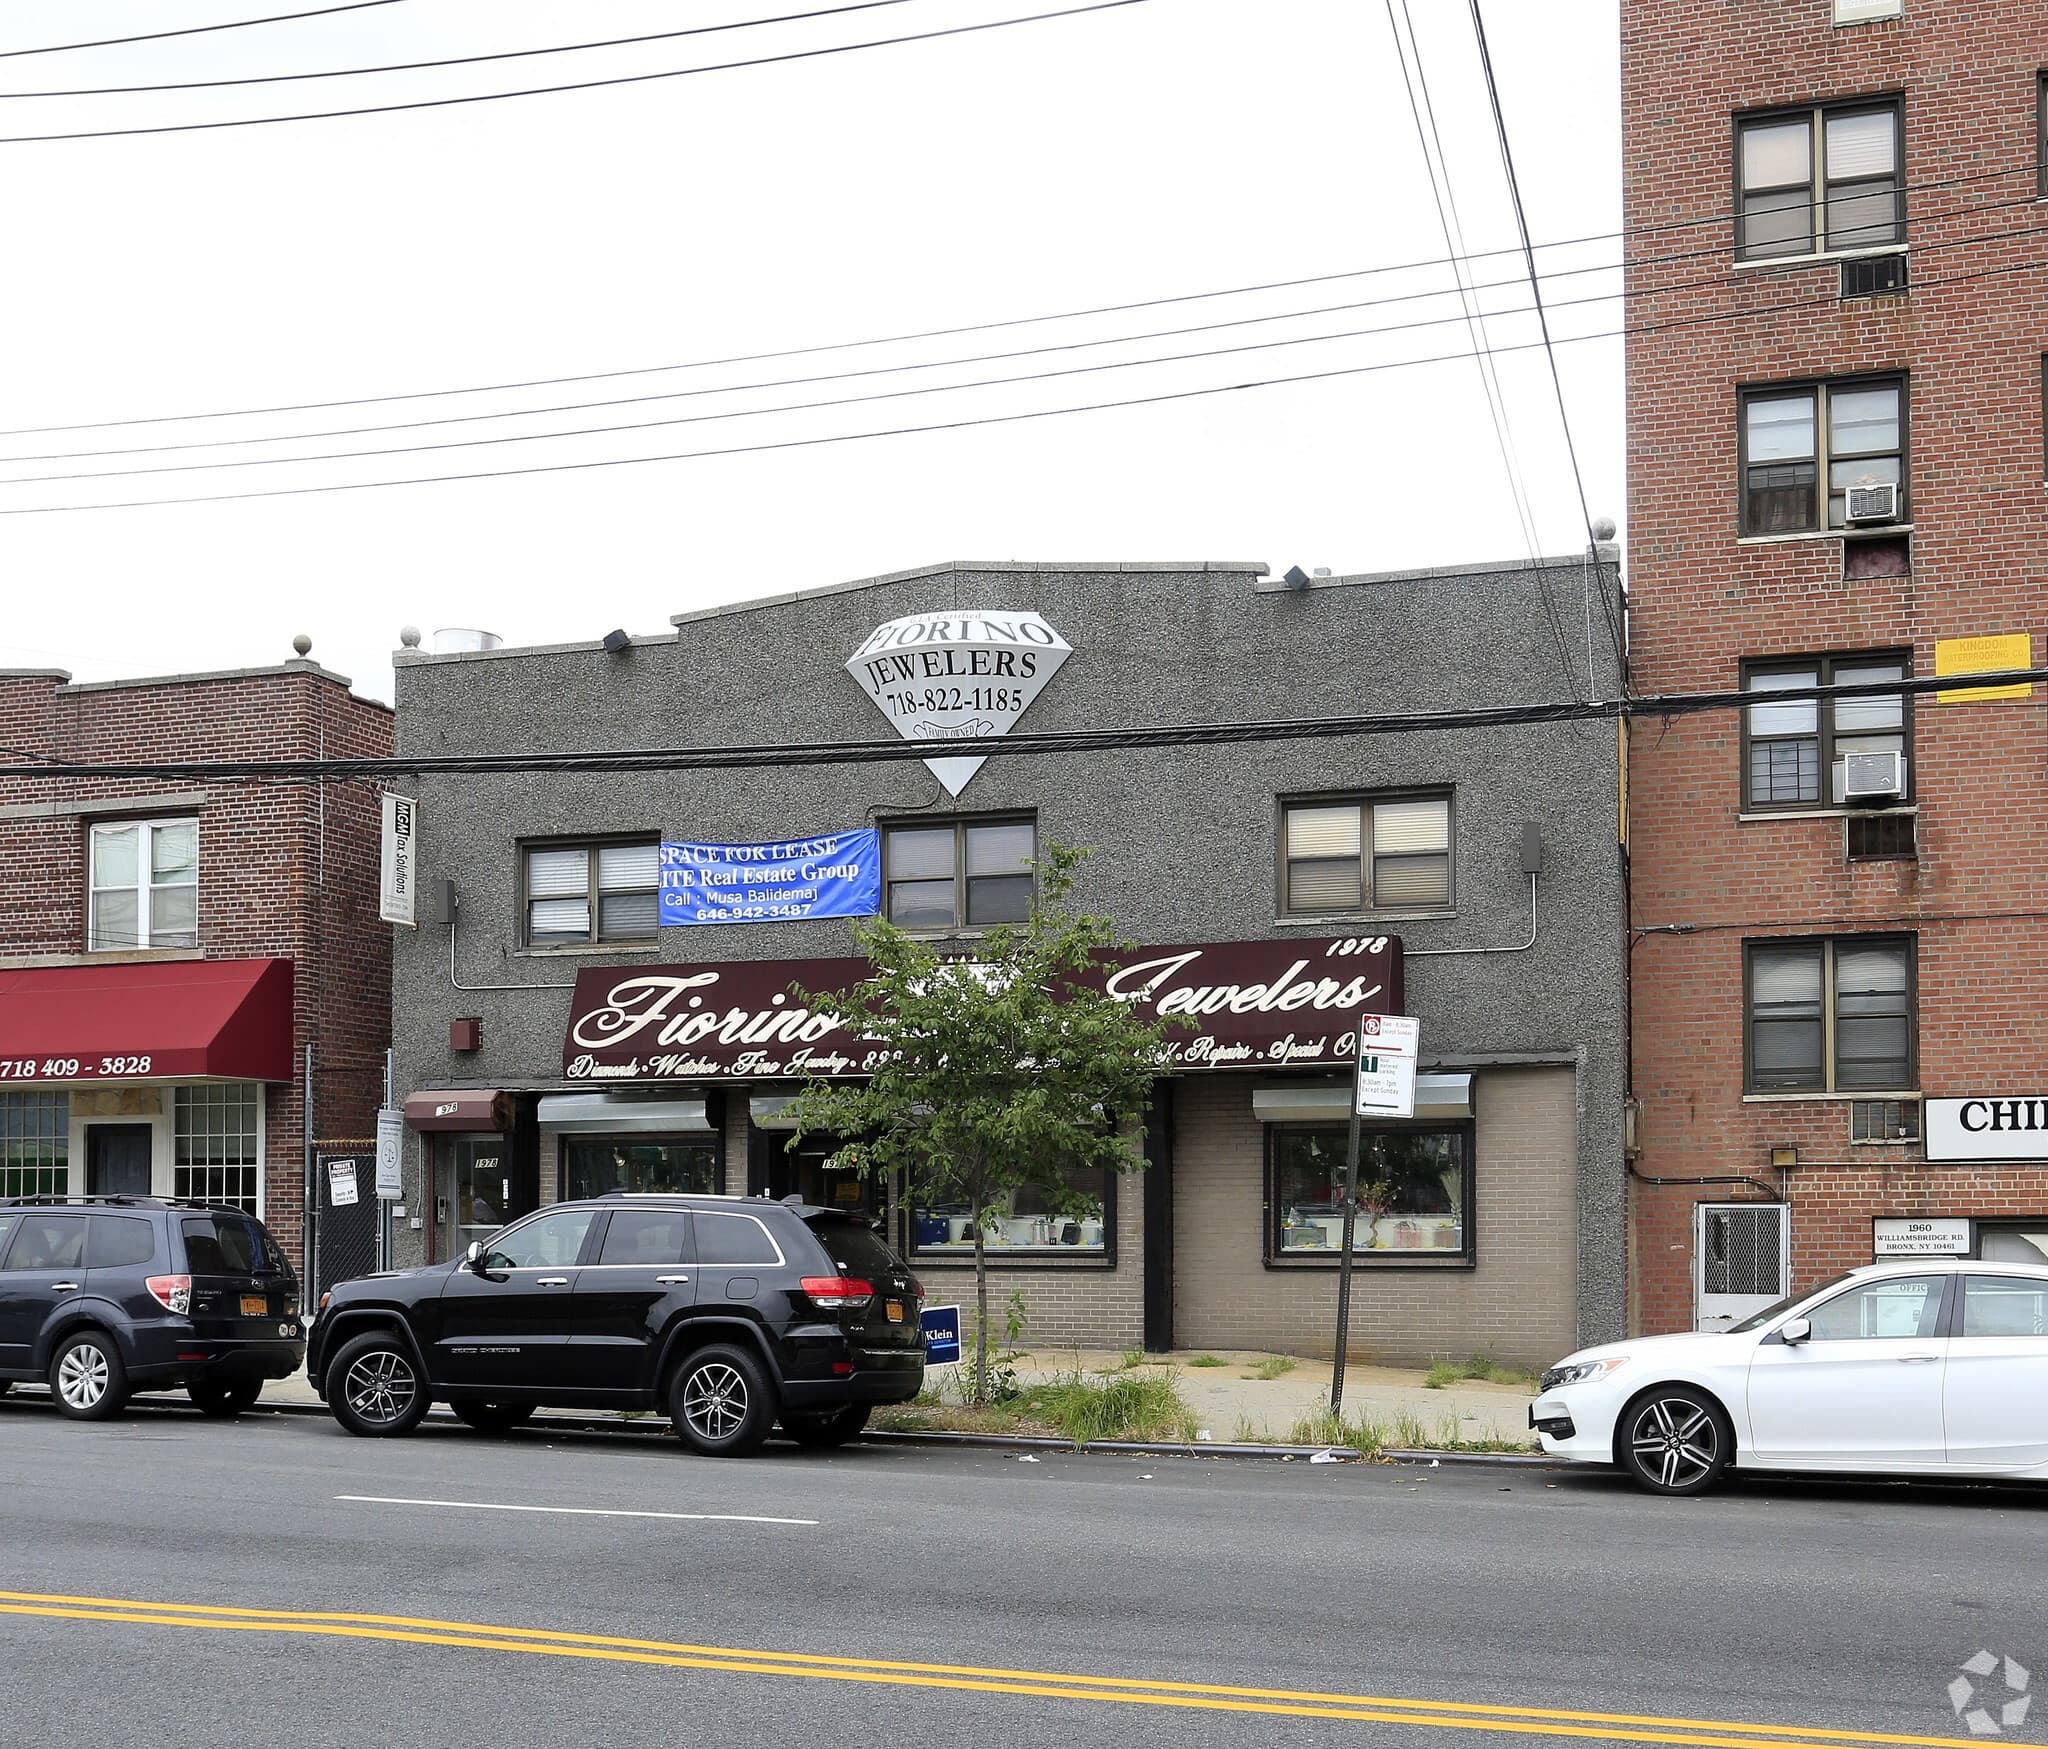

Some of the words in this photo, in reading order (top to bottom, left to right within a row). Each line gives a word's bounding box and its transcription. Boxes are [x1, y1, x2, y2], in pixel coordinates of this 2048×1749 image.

[857, 620, 1055, 656] FIORINO
[1959, 638, 2008, 652] KINGDOM
[1943, 650, 2009, 662] WATERPROOFING
[864, 650, 1037, 694] JEWELERS
[887, 688, 1022, 716] 718-822-1185
[397, 802, 410, 836] MGM
[396, 835, 409, 852] Tax
[659, 847, 721, 865] SPACE
[725, 846, 767, 863] FOR
[772, 837, 839, 860] LEASE
[395, 853, 409, 895] Solutions
[659, 869, 696, 888] ITE
[700, 868, 738, 887] Real
[742, 866, 797, 885] Estate
[801, 862, 860, 882] Group
[664, 893, 691, 906] Call
[706, 891, 743, 904] Musa
[747, 886, 819, 903] Balidemaj
[696, 903, 813, 921] 646-942-3487
[1325, 936, 1389, 958] 1978
[1105, 951, 1382, 1016] Jewelers
[572, 971, 848, 1048] Fiorino
[1184, 1035, 1252, 1067] Repairs
[1267, 1033, 1328, 1064] Special
[0, 1060, 36, 1078] 718
[40, 1058, 80, 1077] 409
[98, 1056, 152, 1075] 3828
[566, 1053, 641, 1078] Diamonds
[648, 1052, 721, 1076] Watches
[730, 1050, 780, 1075] Fine
[437, 1102, 457, 1115] 978
[1959, 1100, 2048, 1132] CHI
[1877, 1234, 1949, 1242] WILLIAMSBRIDGE
[1908, 1224, 1932, 1232] 1960
[1900, 1283, 1927, 1292] OFFIC
[925, 1329, 953, 1341] Klein
